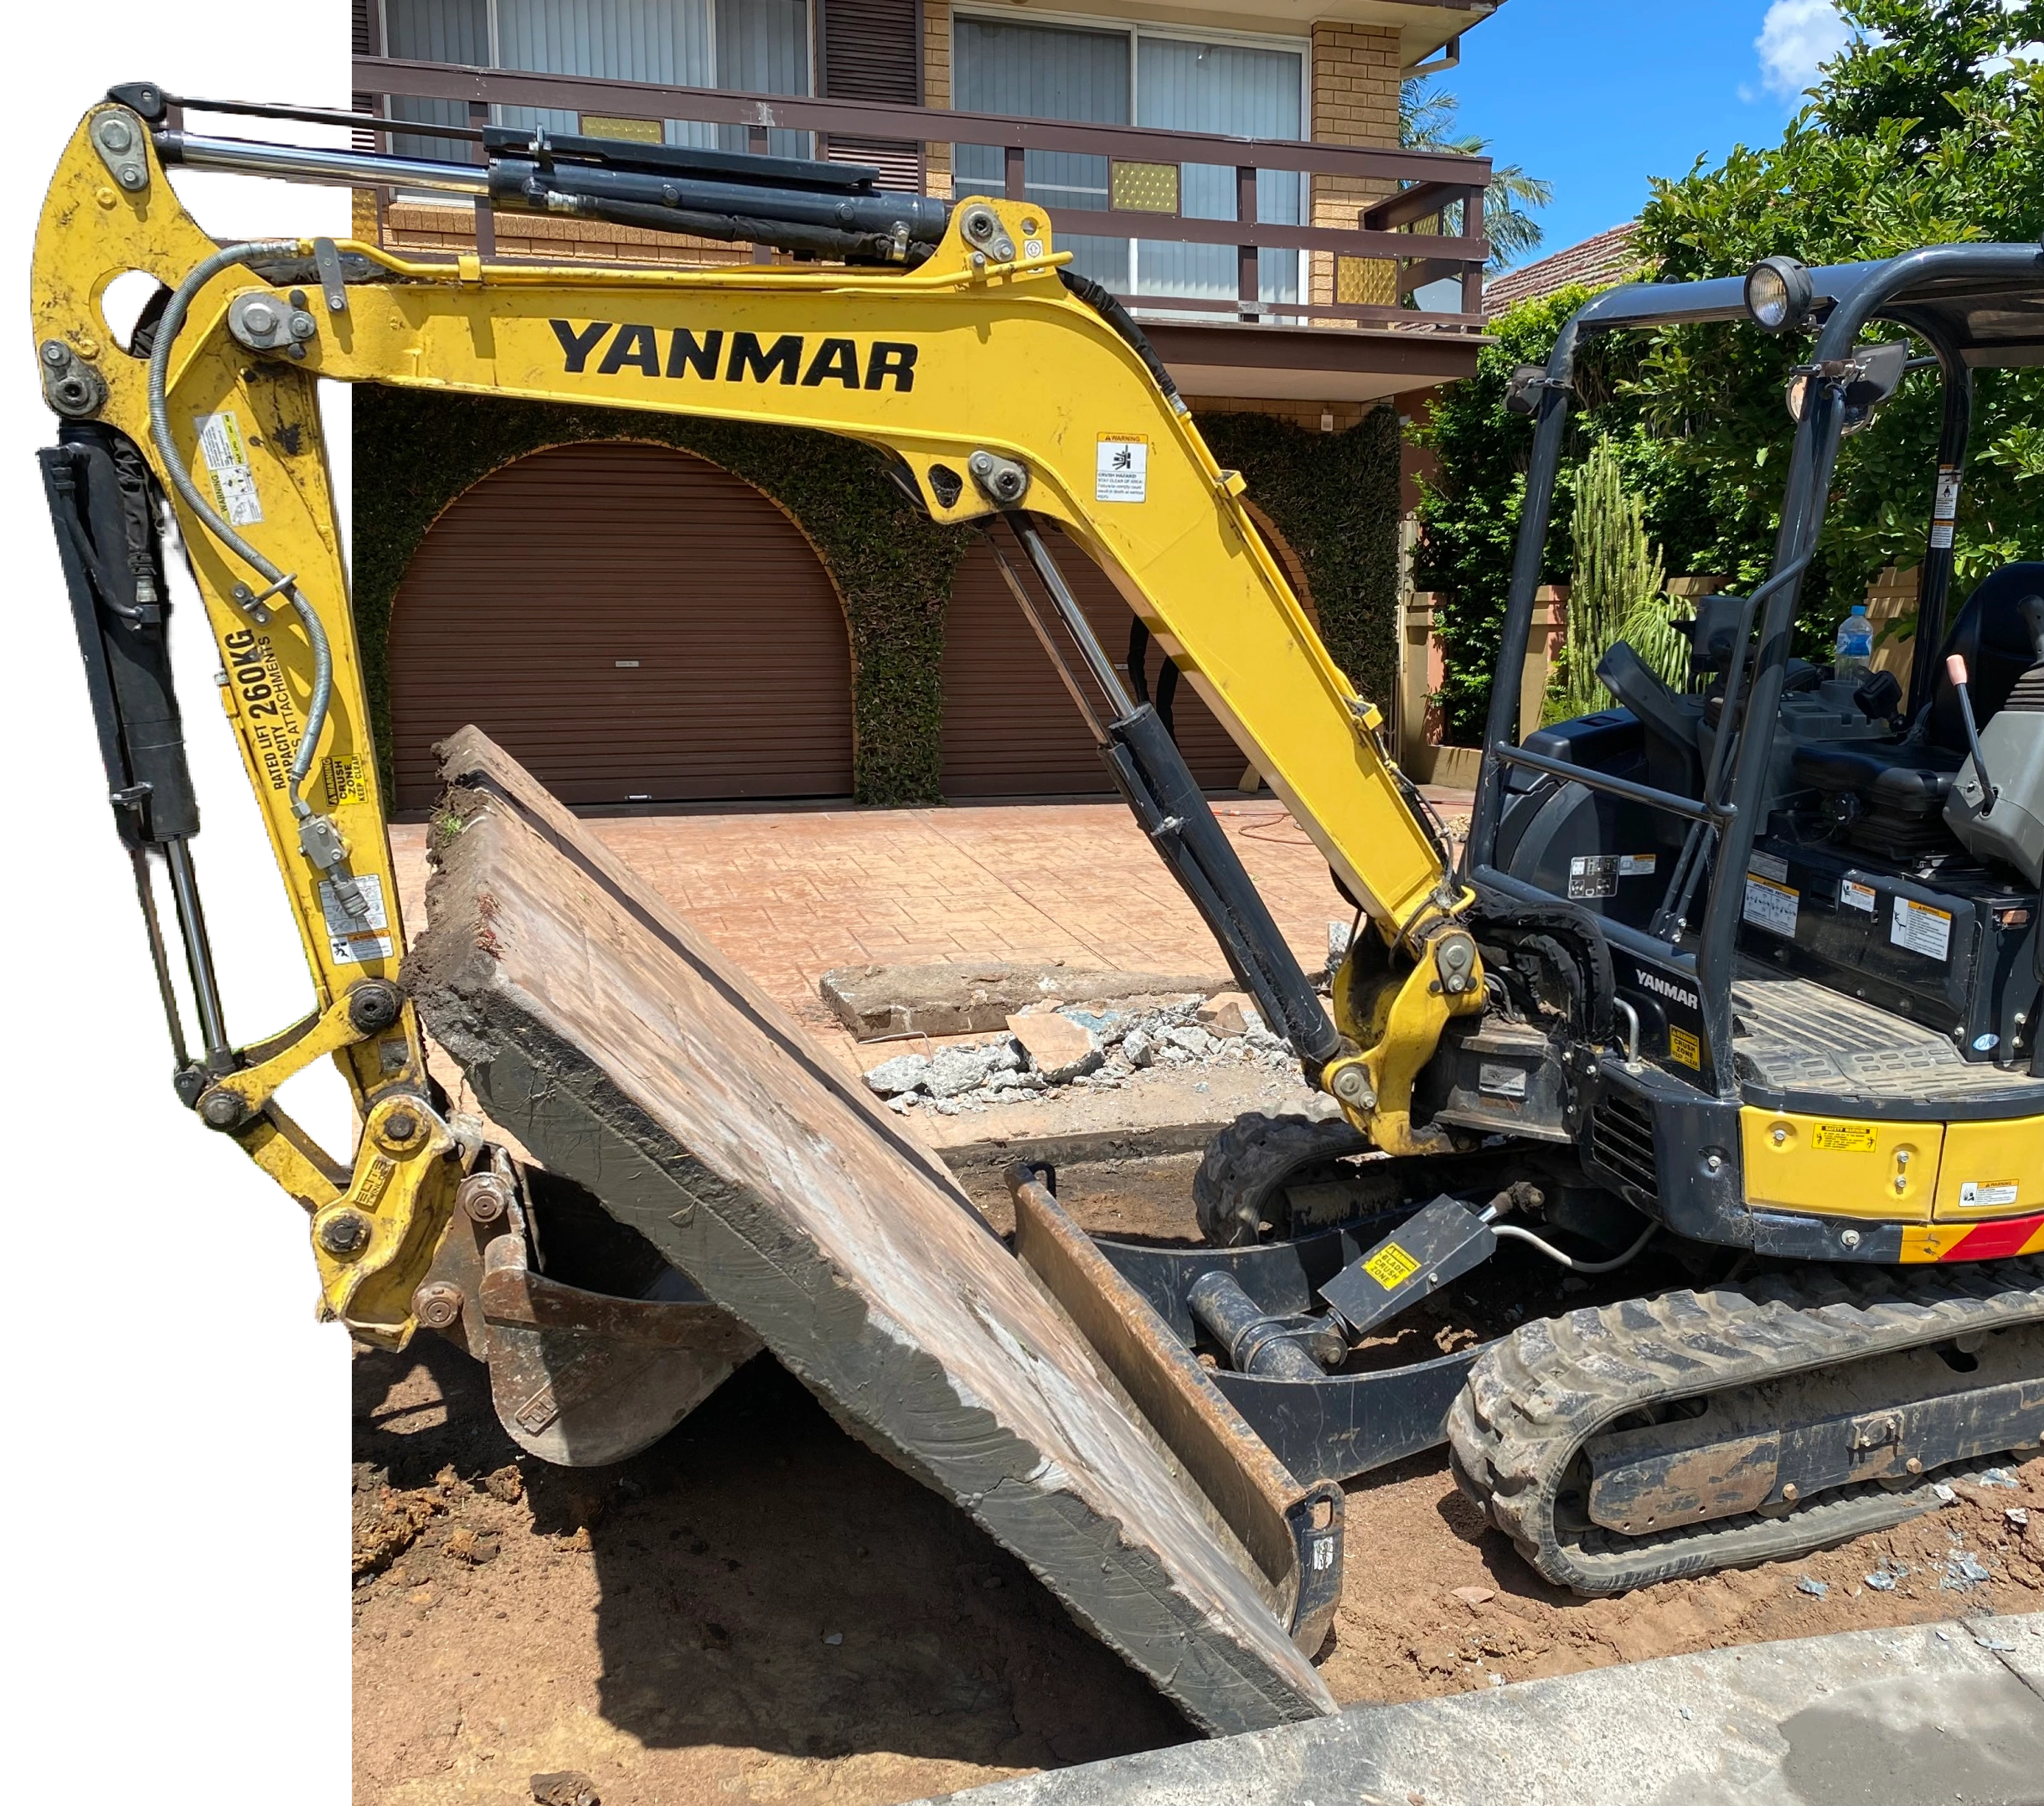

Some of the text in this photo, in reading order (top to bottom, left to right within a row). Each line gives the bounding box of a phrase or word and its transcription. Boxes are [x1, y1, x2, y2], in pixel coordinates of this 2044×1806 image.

[548, 318, 919, 392] YANMAR
[211, 474, 228, 512] WARNING
[225, 629, 278, 720] 260KG
[258, 636, 301, 735] ATTACHMENTS
[254, 725, 286, 789] RATED LIFT
[323, 758, 336, 796] WARNING
[334, 761, 348, 799] CRUSH
[344, 764, 356, 794] ZONE
[352, 756, 366, 802] KEEP CLEAR
[1635, 968, 1698, 1010] YANMAR
[1674, 1039, 1696, 1052] CRUSH
[1677, 1045, 1694, 1059] ZONE
[1371, 1266, 1391, 1283] ZONE
[1375, 1259, 1399, 1280] CRUSH
[1381, 1254, 1407, 1275] BLADE
